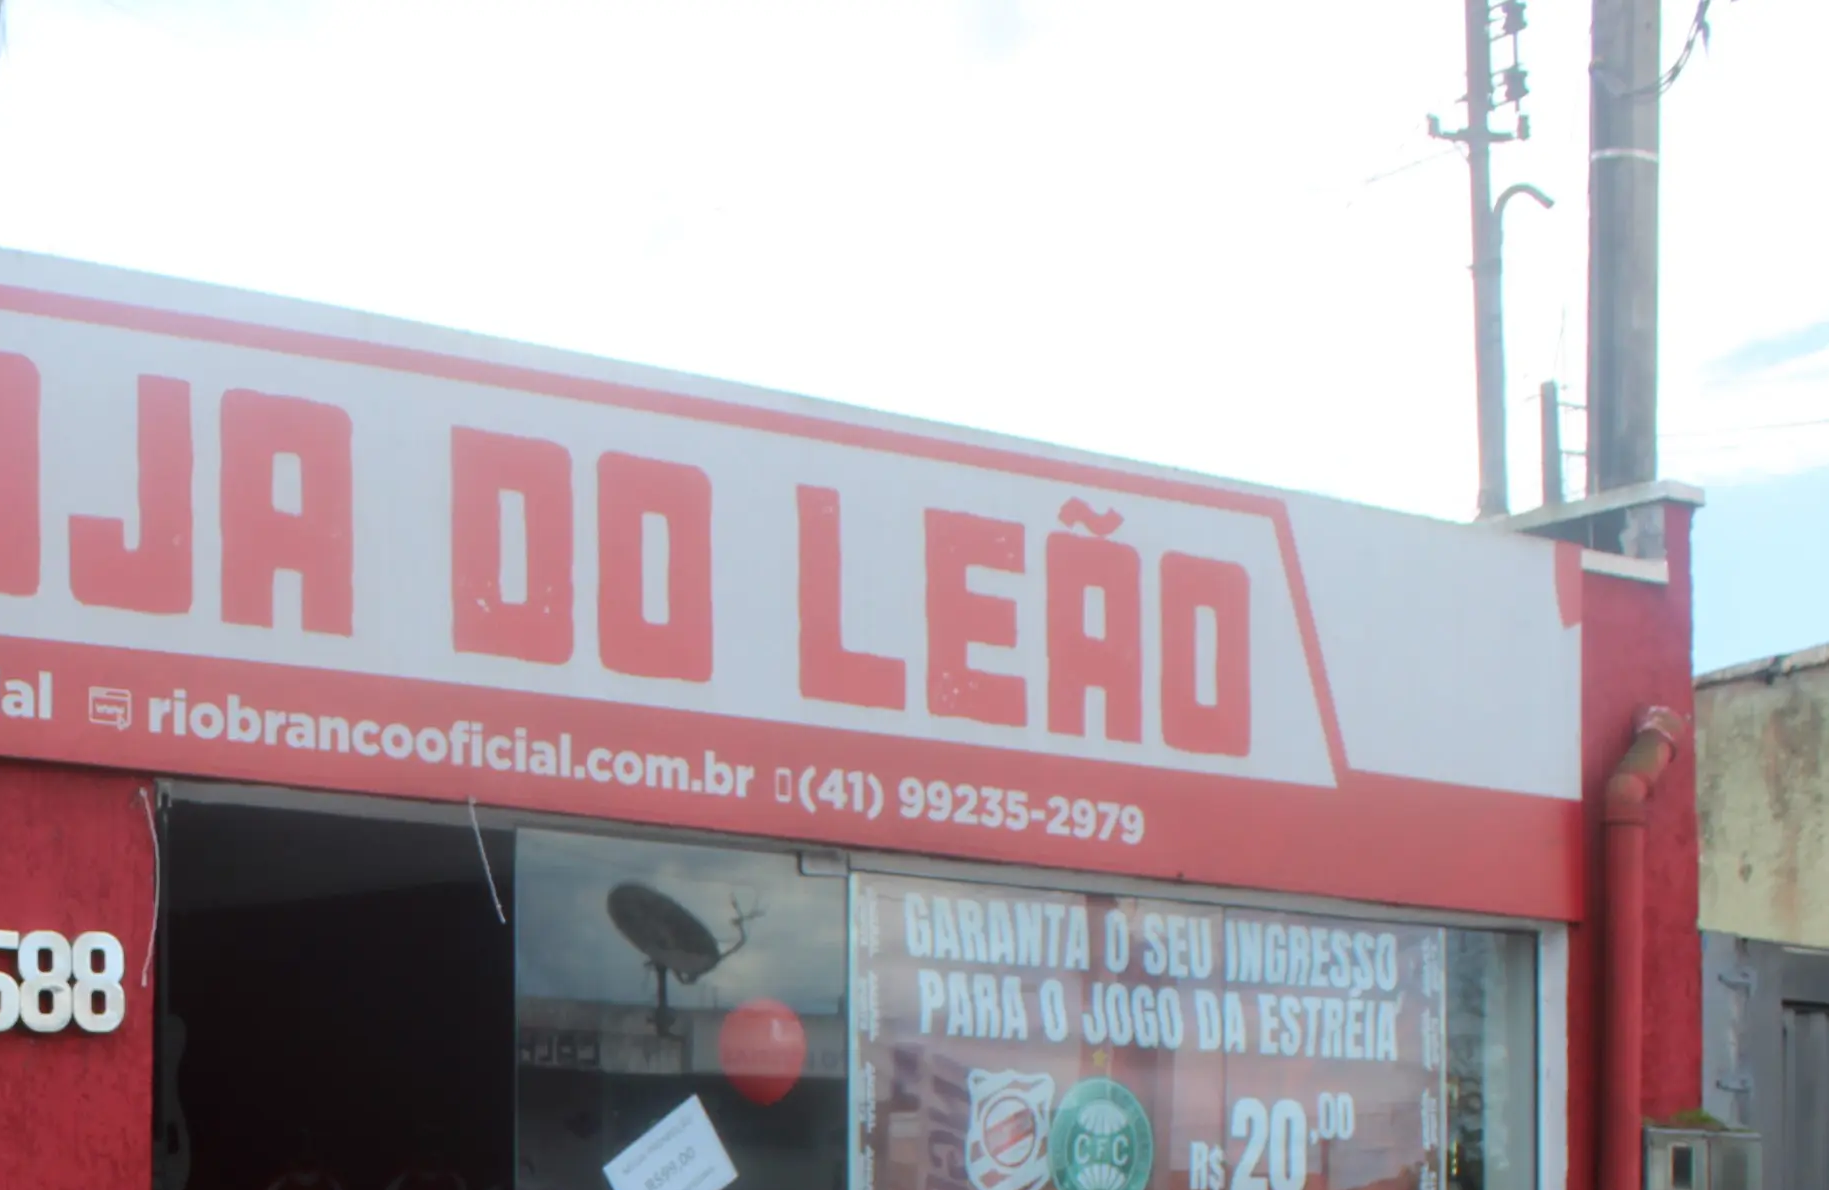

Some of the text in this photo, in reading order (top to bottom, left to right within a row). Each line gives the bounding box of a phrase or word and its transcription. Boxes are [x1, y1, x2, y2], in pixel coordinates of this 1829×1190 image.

[450, 425, 713, 684] DO
[794, 484, 1251, 758] LEÃO
[147, 689, 756, 798] riobrancooficial.com.br
[797, 765, 1145, 845] (41) 99235-2979
[903, 892, 1400, 992] GARANTA O SEU INGRESSO
[918, 969, 1029, 1041] PARA
[1039, 978, 1070, 1044] O
[1081, 983, 1185, 1050] JOGO
[1196, 989, 1247, 1054] DA
